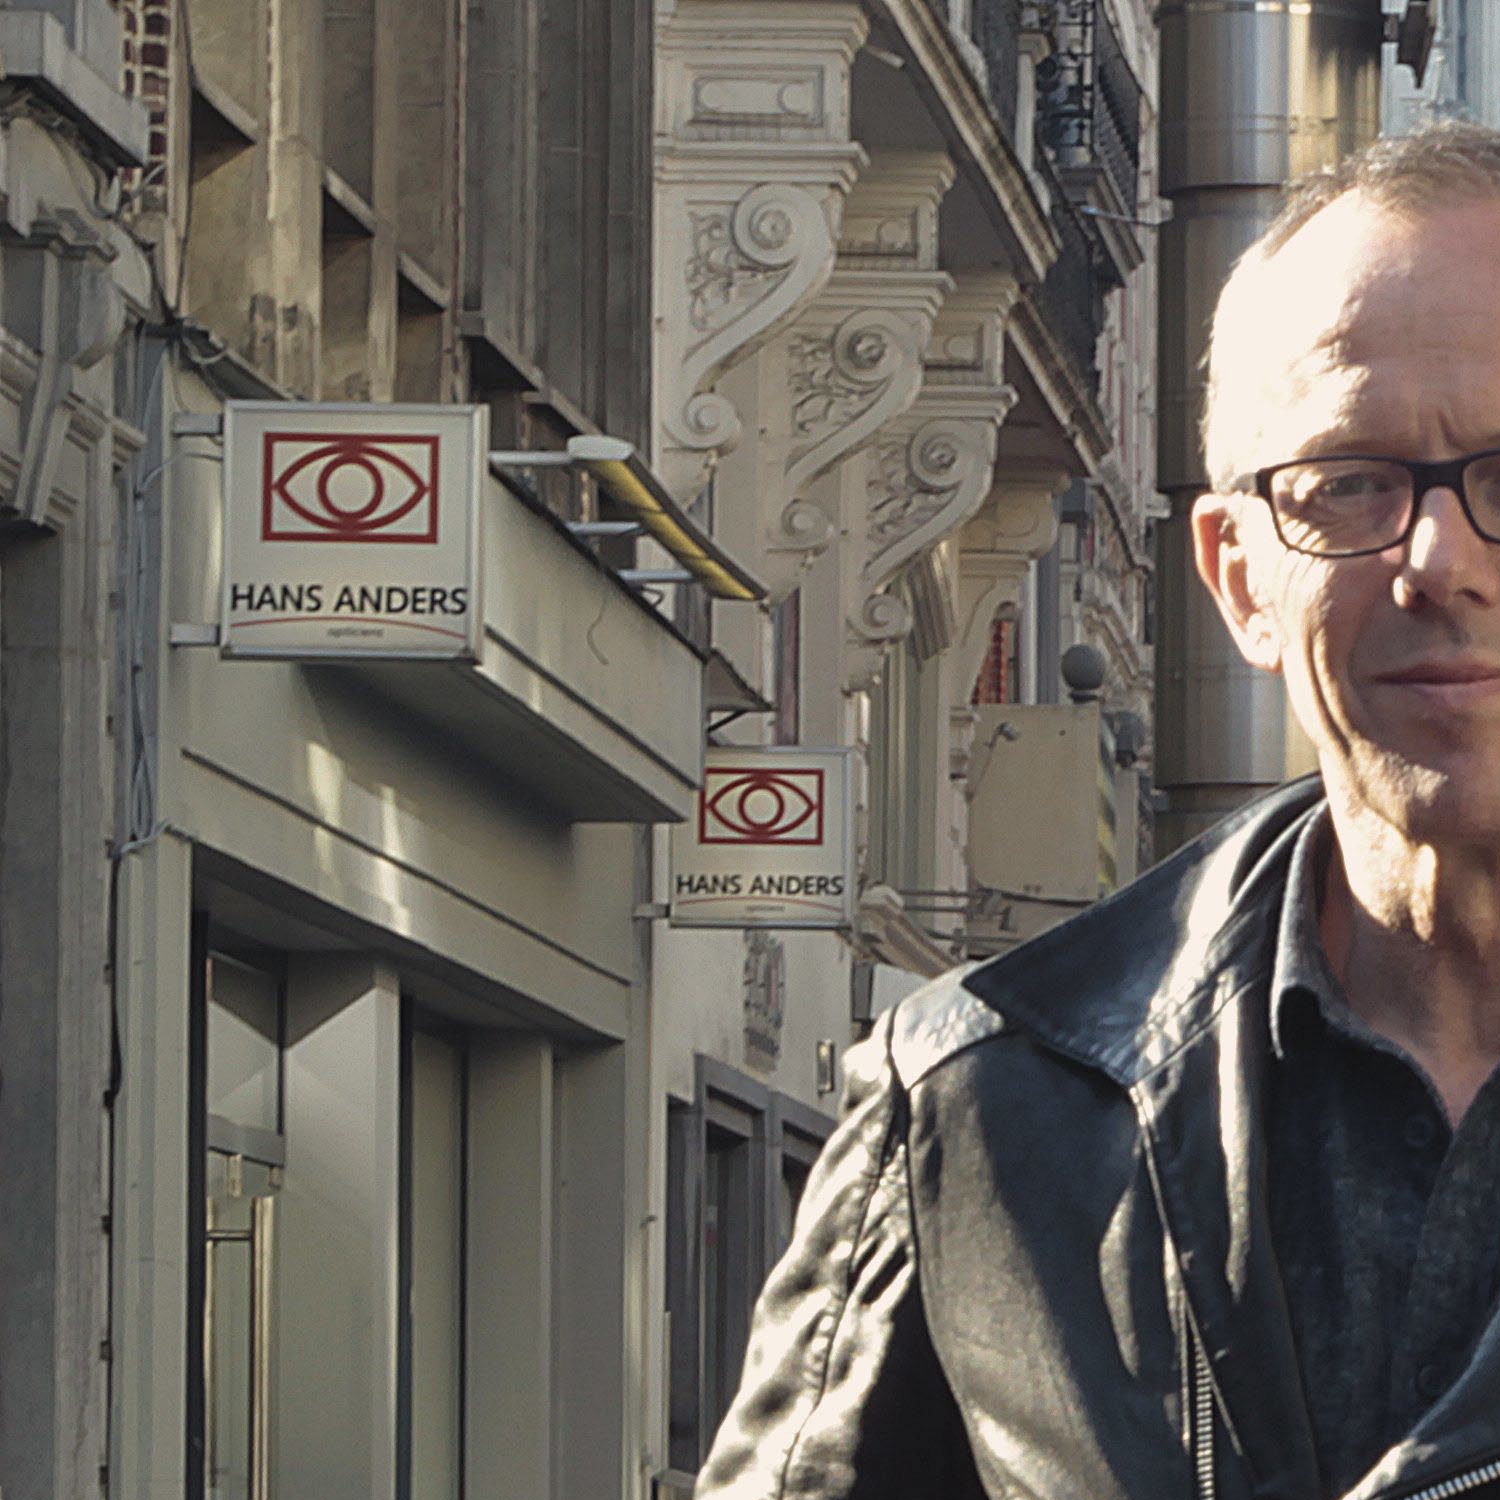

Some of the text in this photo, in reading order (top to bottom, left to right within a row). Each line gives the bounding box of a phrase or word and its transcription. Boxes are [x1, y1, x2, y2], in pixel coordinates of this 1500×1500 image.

[231, 583, 469, 614] HANS ANDERS
[676, 874, 844, 896] HANS ANDERS
